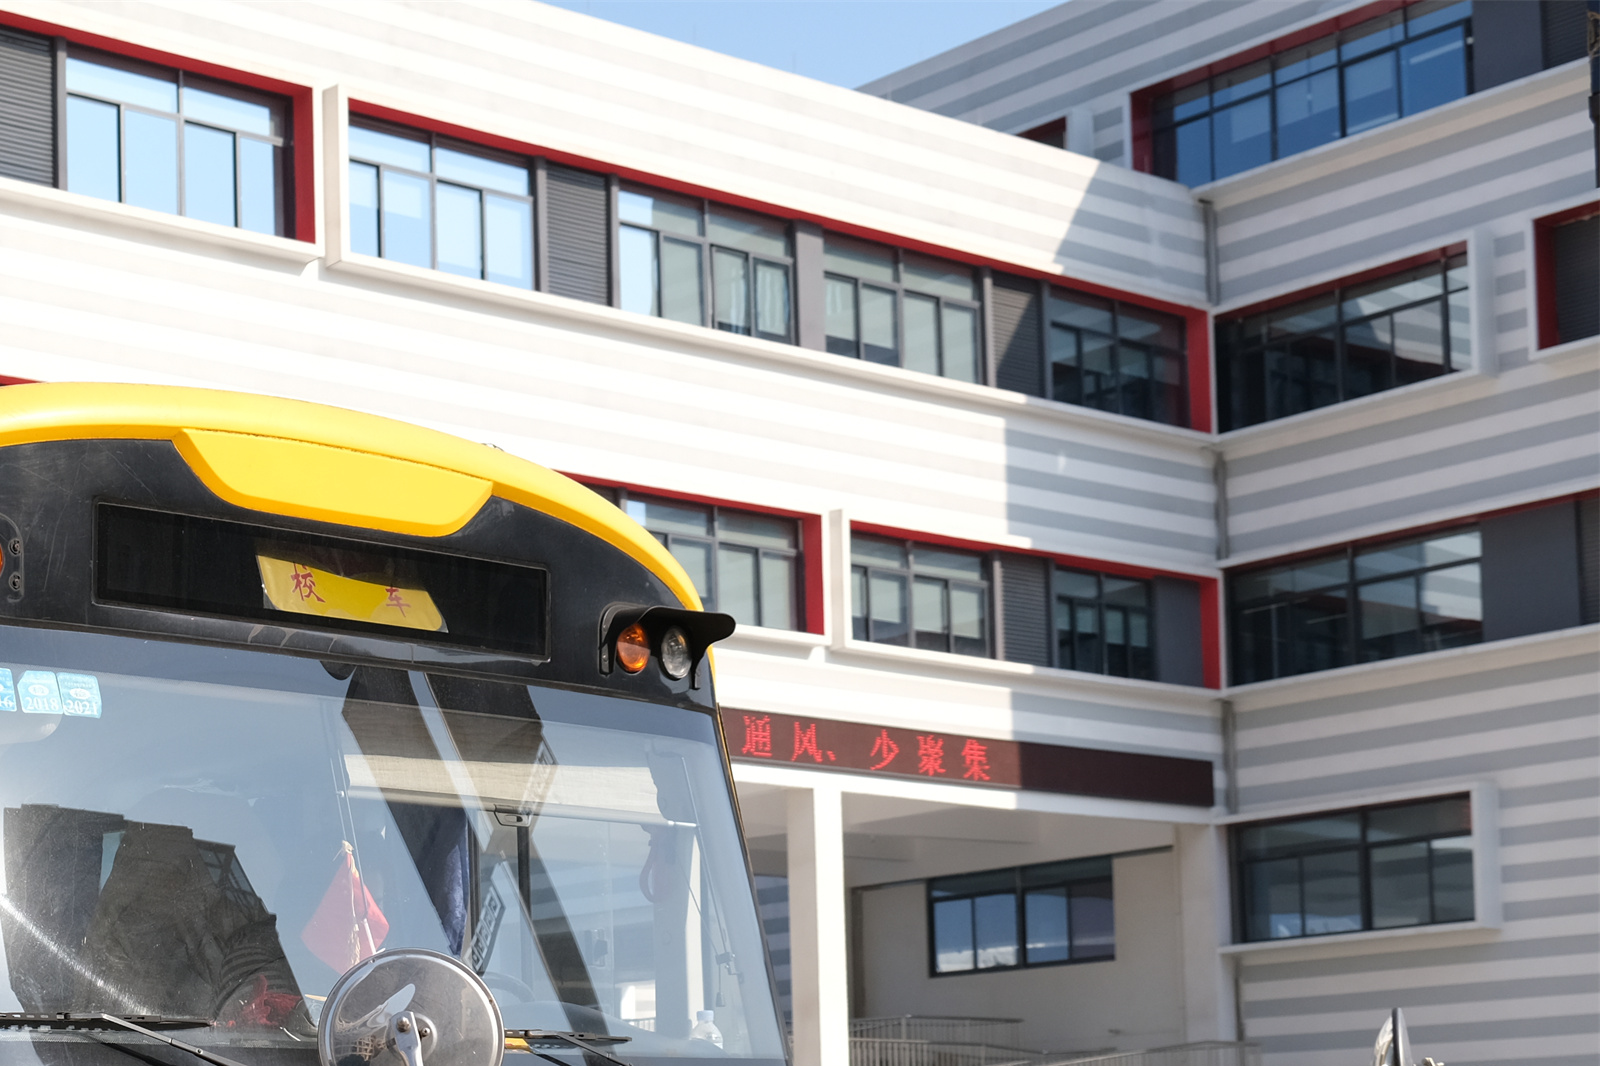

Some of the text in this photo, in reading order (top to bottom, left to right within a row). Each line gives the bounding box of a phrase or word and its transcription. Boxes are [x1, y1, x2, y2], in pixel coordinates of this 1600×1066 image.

[290, 562, 412, 619] 校车
[25, 697, 60, 711] 2018
[65, 700, 99, 715] 2021
[741, 714, 991, 781] 通风、少聚集
